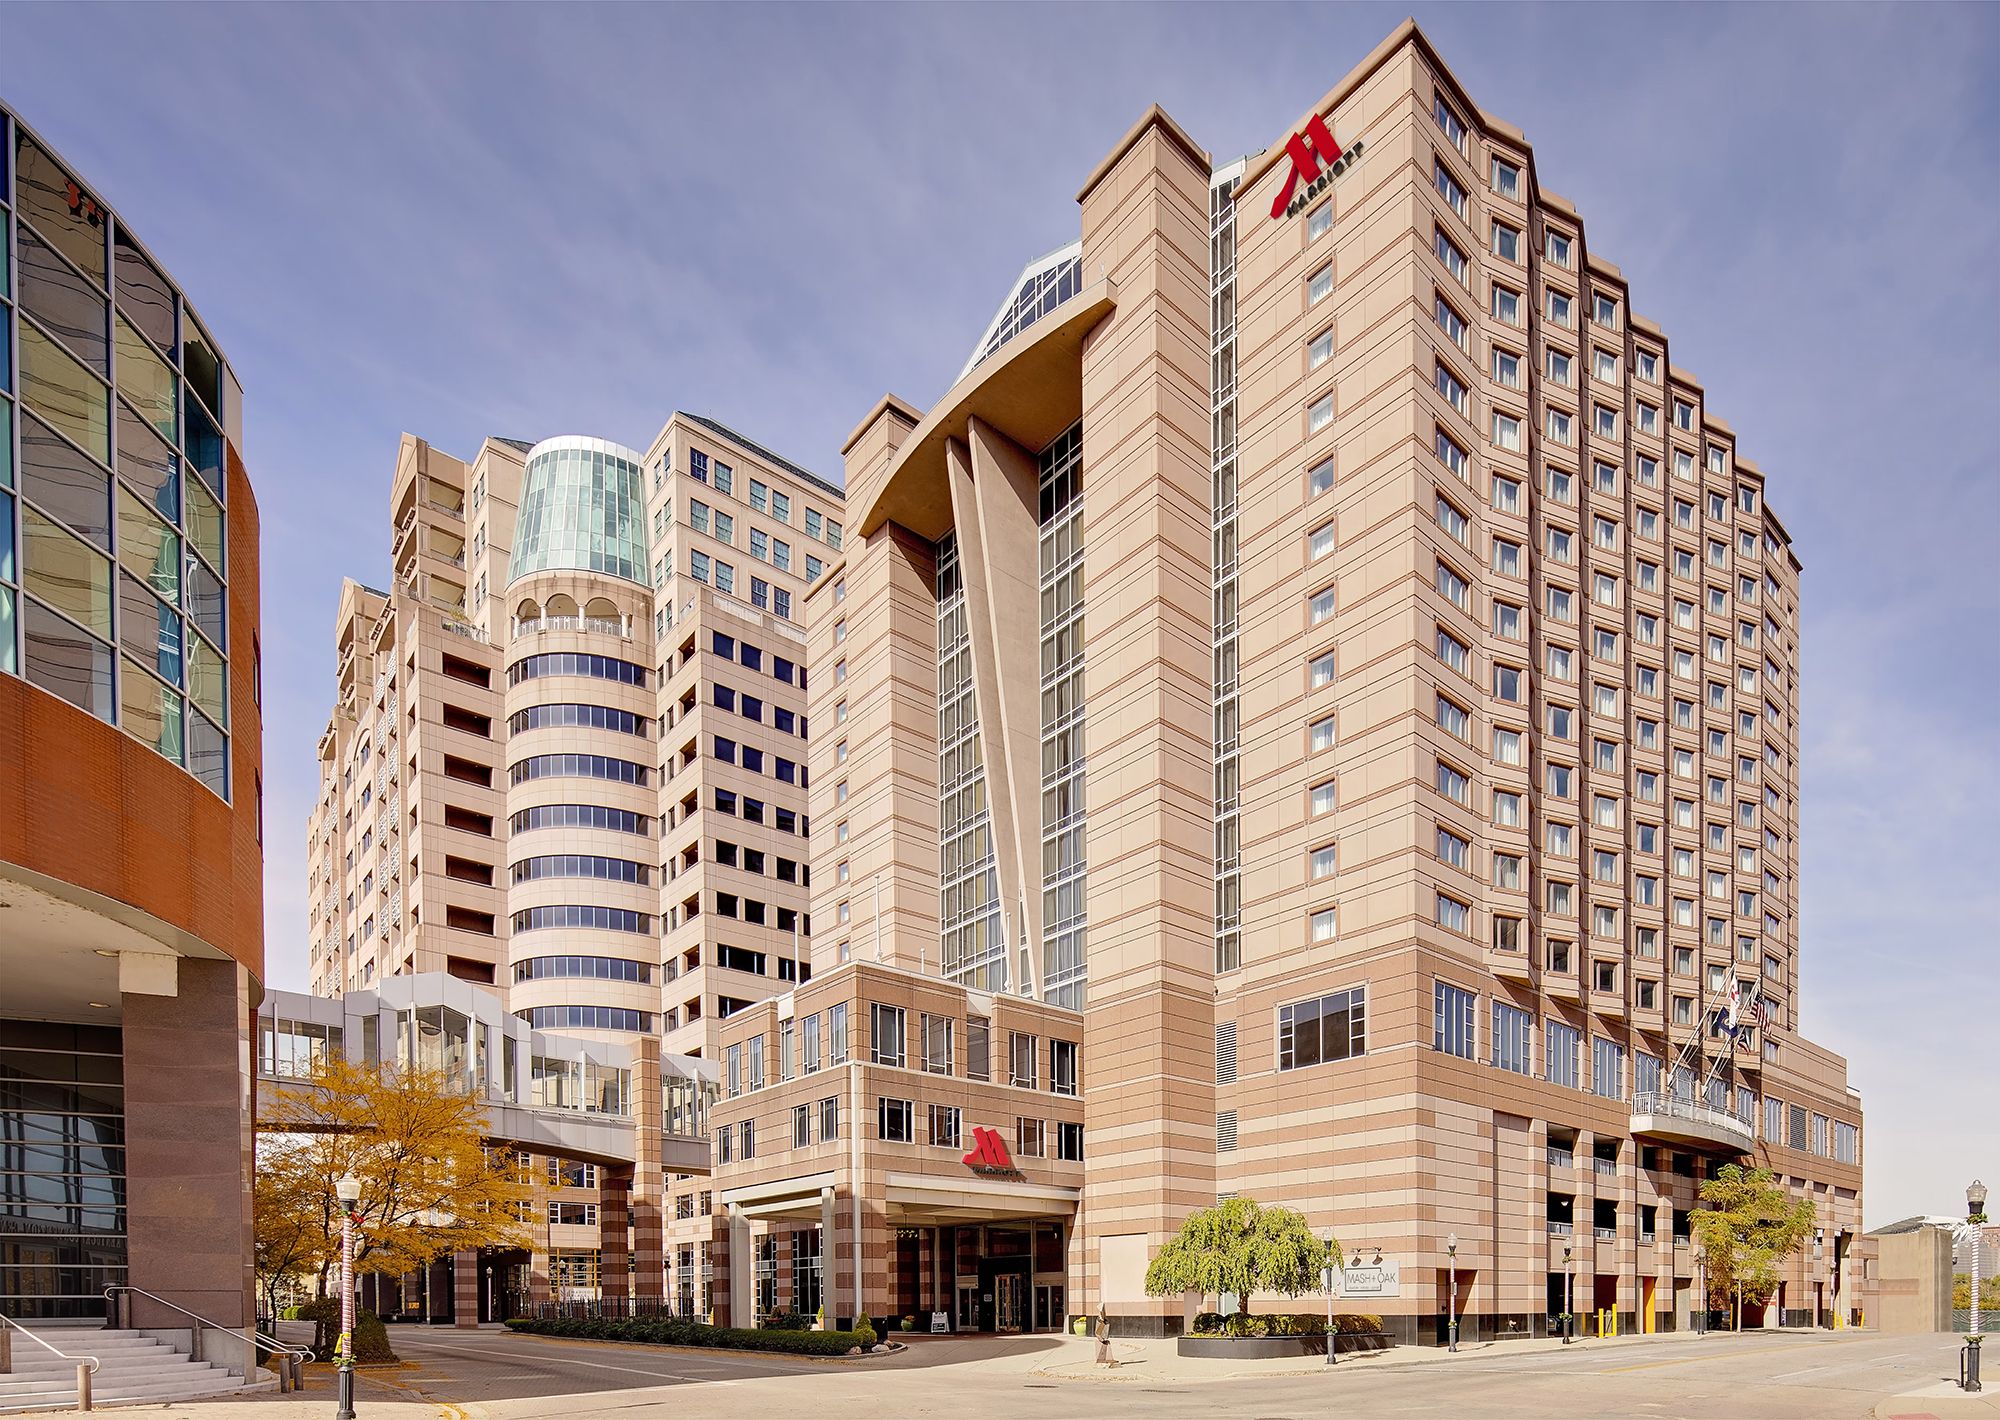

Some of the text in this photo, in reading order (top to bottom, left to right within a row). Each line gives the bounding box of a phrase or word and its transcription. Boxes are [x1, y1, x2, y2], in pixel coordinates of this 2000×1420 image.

[1286, 141, 1364, 219] MARRIOTT
[1347, 1273, 1371, 1284] MASH
[1377, 1272, 1396, 1284] OAK
